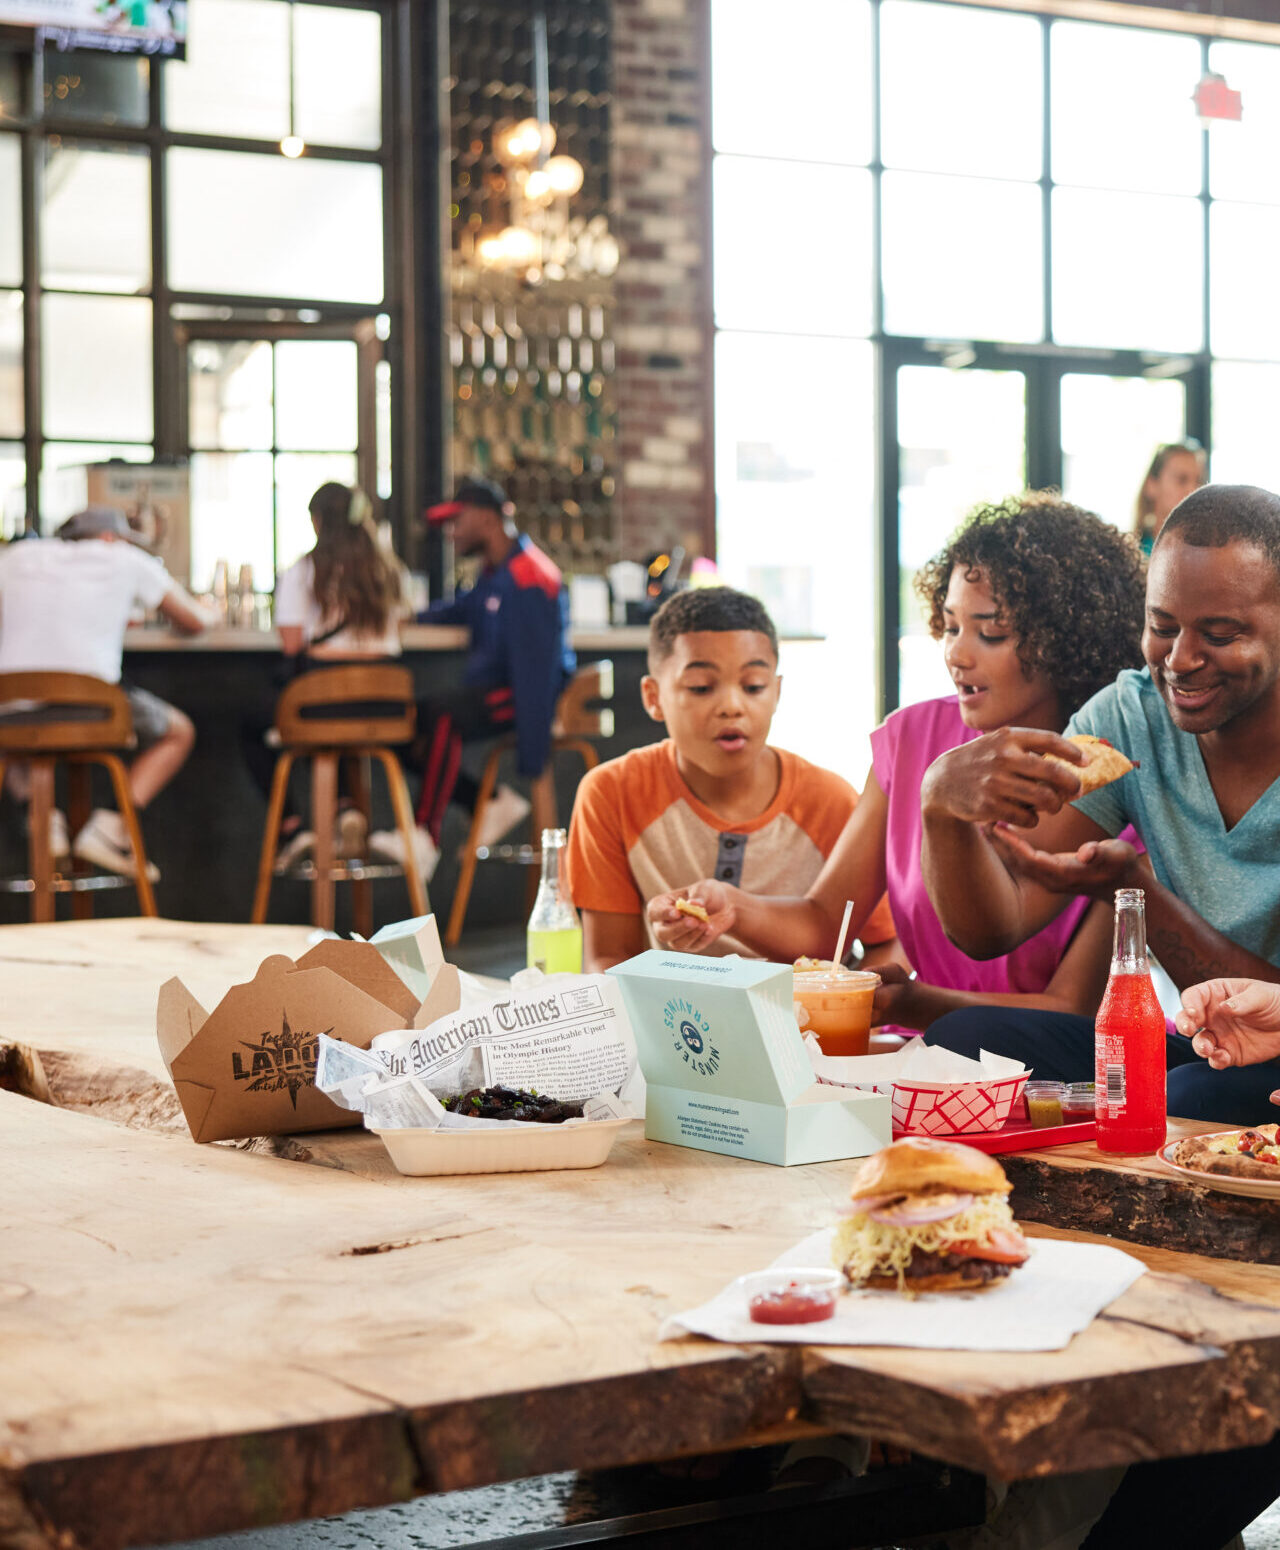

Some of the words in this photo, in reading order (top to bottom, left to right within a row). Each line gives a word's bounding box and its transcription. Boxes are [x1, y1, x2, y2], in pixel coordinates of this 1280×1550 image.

[663, 998, 710, 1032] CRAVINGS
[409, 1015, 492, 1072] American
[493, 995, 561, 1031] Times
[492, 1043, 508, 1051] The
[510, 1041, 531, 1049] Most
[533, 1029, 582, 1046] Remarkable
[583, 1023, 607, 1035] Upset
[232, 1050, 275, 1080] LA
[492, 1052, 501, 1060] in
[503, 1049, 539, 1060] Olympic
[541, 1043, 573, 1055] History
[674, 1041, 720, 1076] MUNSTER
